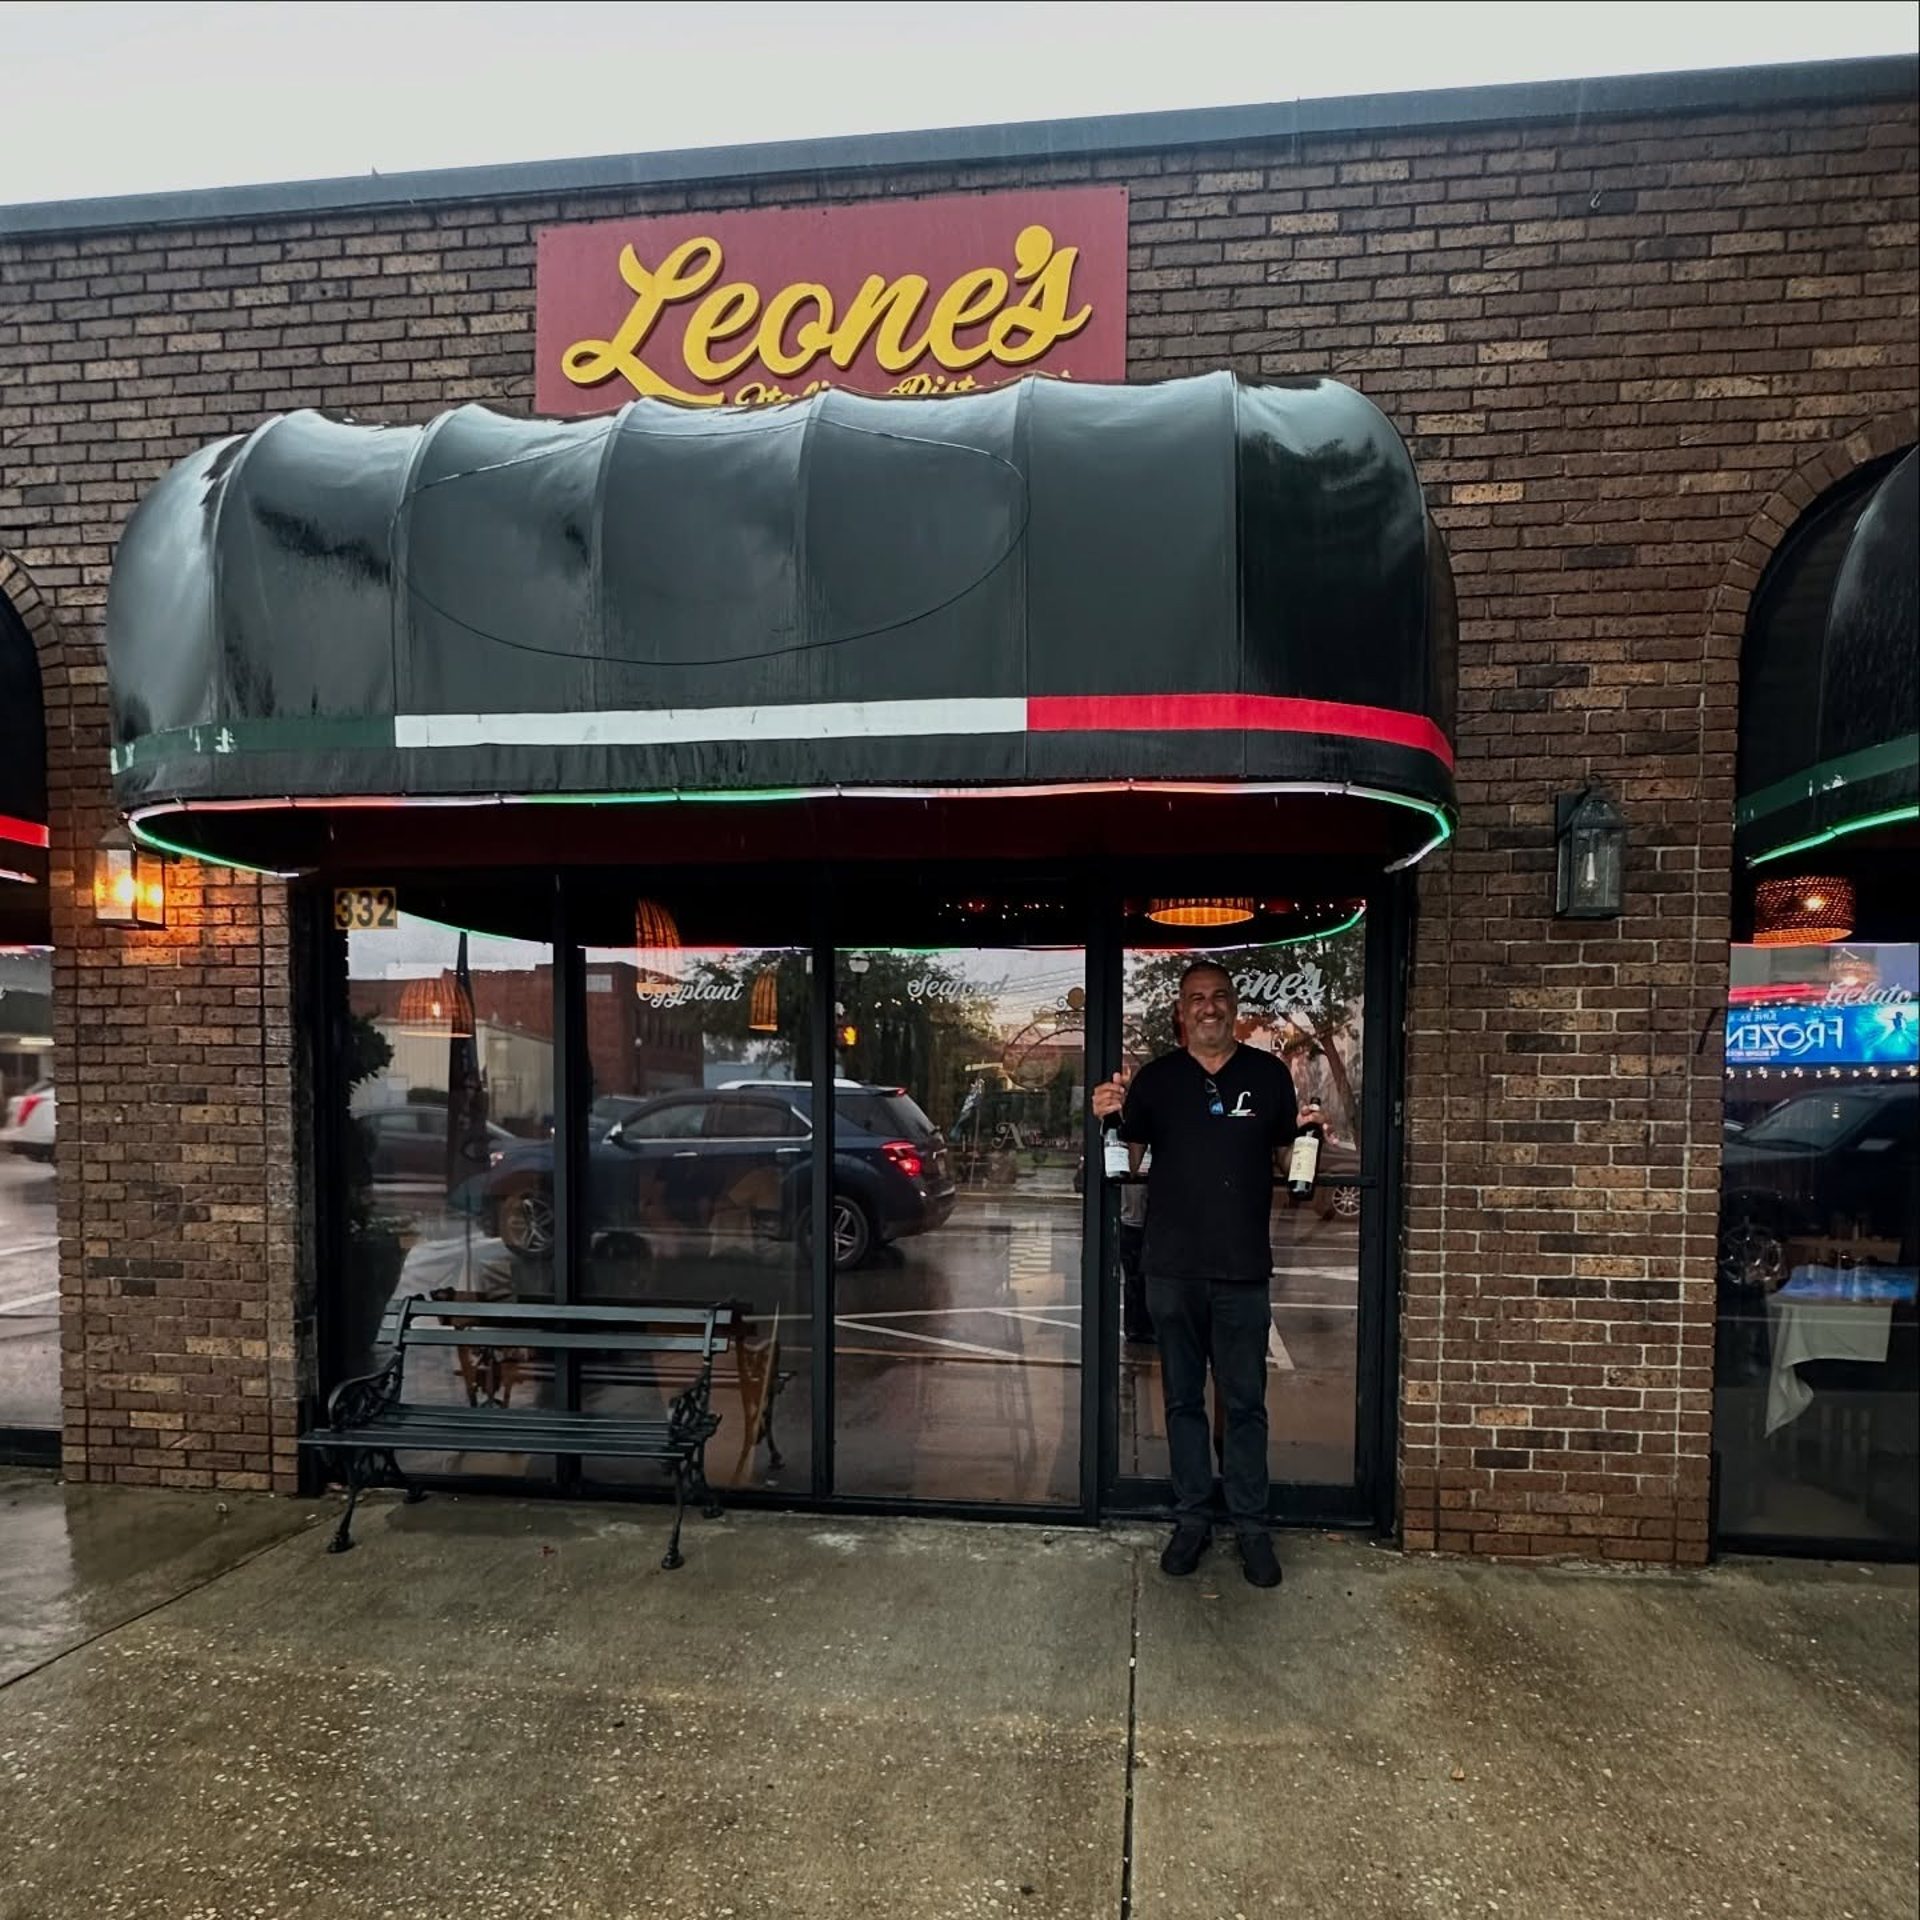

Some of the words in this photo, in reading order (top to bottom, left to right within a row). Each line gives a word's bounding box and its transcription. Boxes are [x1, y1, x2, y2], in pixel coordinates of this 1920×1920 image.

[561, 225, 1092, 405] Leone's
[335, 891, 396, 928] 332
[637, 976, 744, 1007] Eggplant
[907, 973, 1009, 1003] Seafood
[1231, 962, 1327, 1000] one's
[1821, 981, 1913, 1007] Gelato
[1230, 1091, 1253, 1114] L
